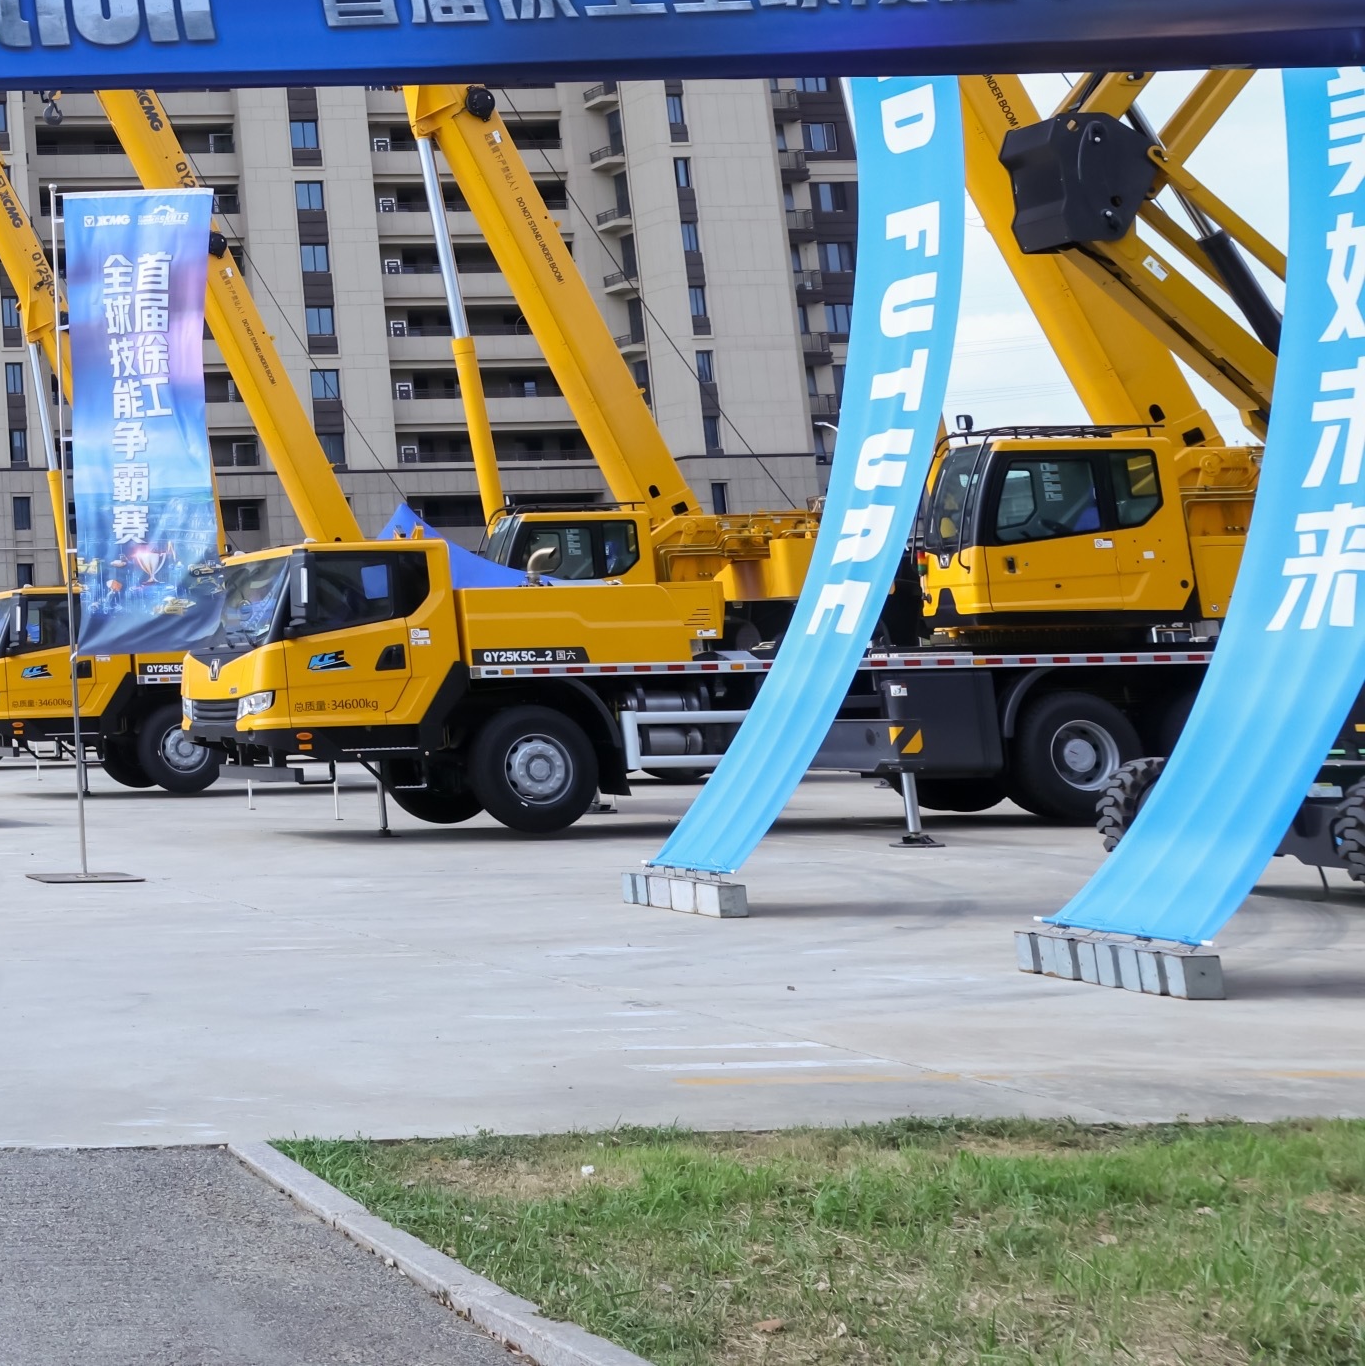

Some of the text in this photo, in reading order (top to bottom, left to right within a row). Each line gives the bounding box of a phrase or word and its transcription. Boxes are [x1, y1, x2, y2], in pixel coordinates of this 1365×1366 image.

[96, 215, 131, 226] XCMG
[521, 206, 532, 222] NOT
[528, 220, 542, 243] STAND
[539, 240, 554, 264] UNDER
[134, 251, 173, 418] 首届徐工
[103, 253, 150, 546] 全球技能争霸赛
[806, 201, 940, 635] FUTURE
[556, 649, 577, 661] 国六
